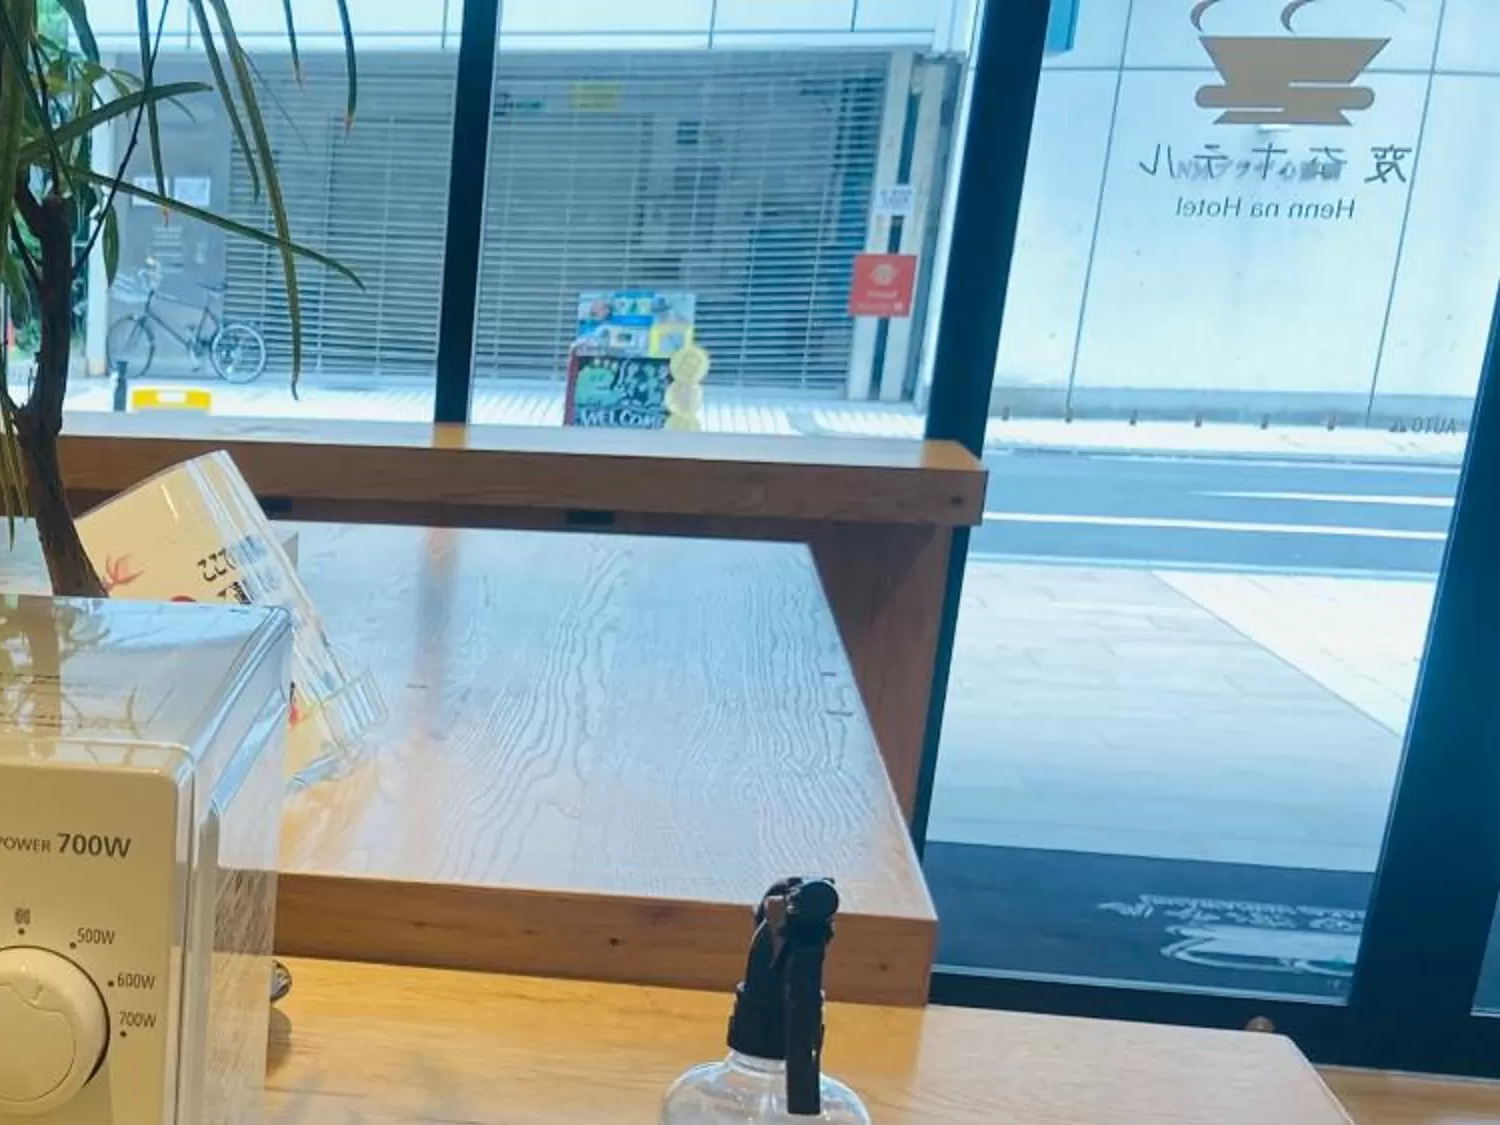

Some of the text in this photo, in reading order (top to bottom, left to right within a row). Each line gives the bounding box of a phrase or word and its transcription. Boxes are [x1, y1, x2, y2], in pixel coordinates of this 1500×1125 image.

[56, 833, 132, 859] 700W
[77, 927, 115, 946] 500W
[117, 972, 156, 990] 600W
[119, 1011, 157, 1029] 700W
